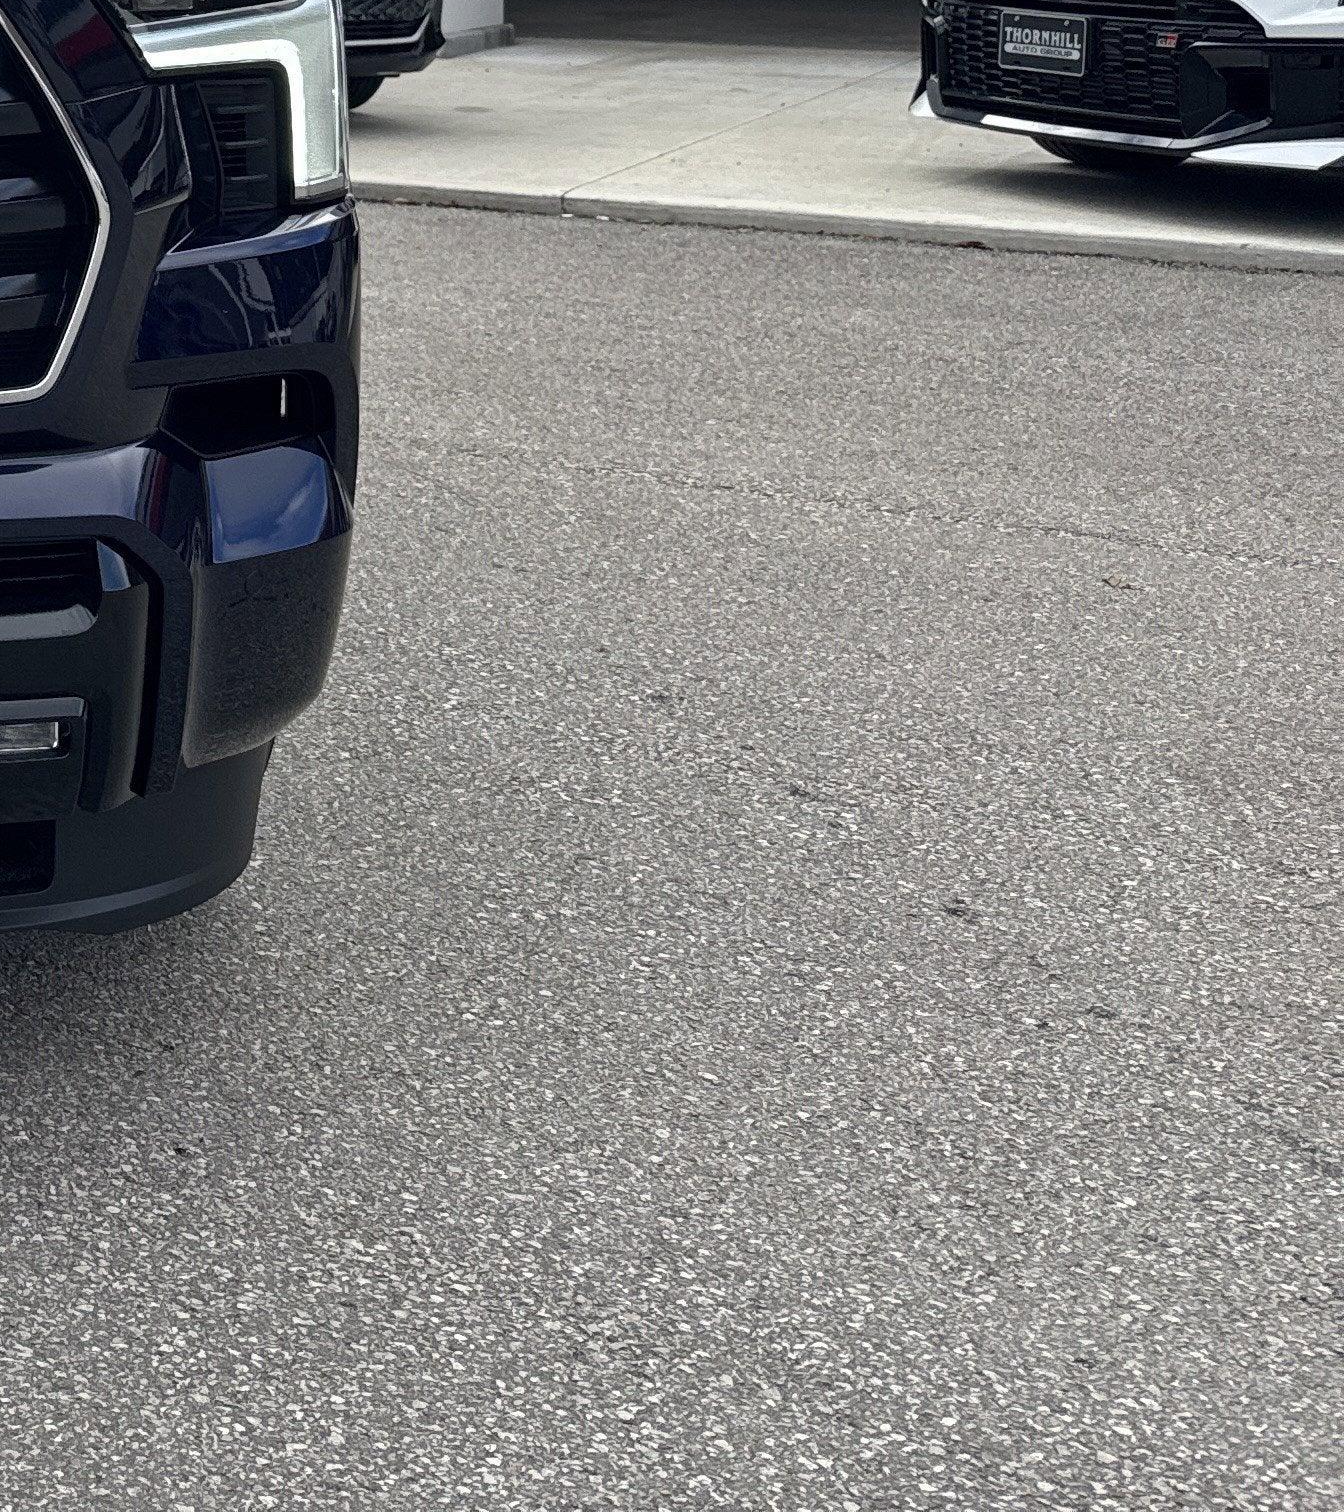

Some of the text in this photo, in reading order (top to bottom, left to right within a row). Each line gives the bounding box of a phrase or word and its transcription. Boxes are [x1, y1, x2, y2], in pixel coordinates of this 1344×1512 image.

[1004, 26, 1082, 49] THORNHILL
[1011, 44, 1073, 58] AUTO GROUP
